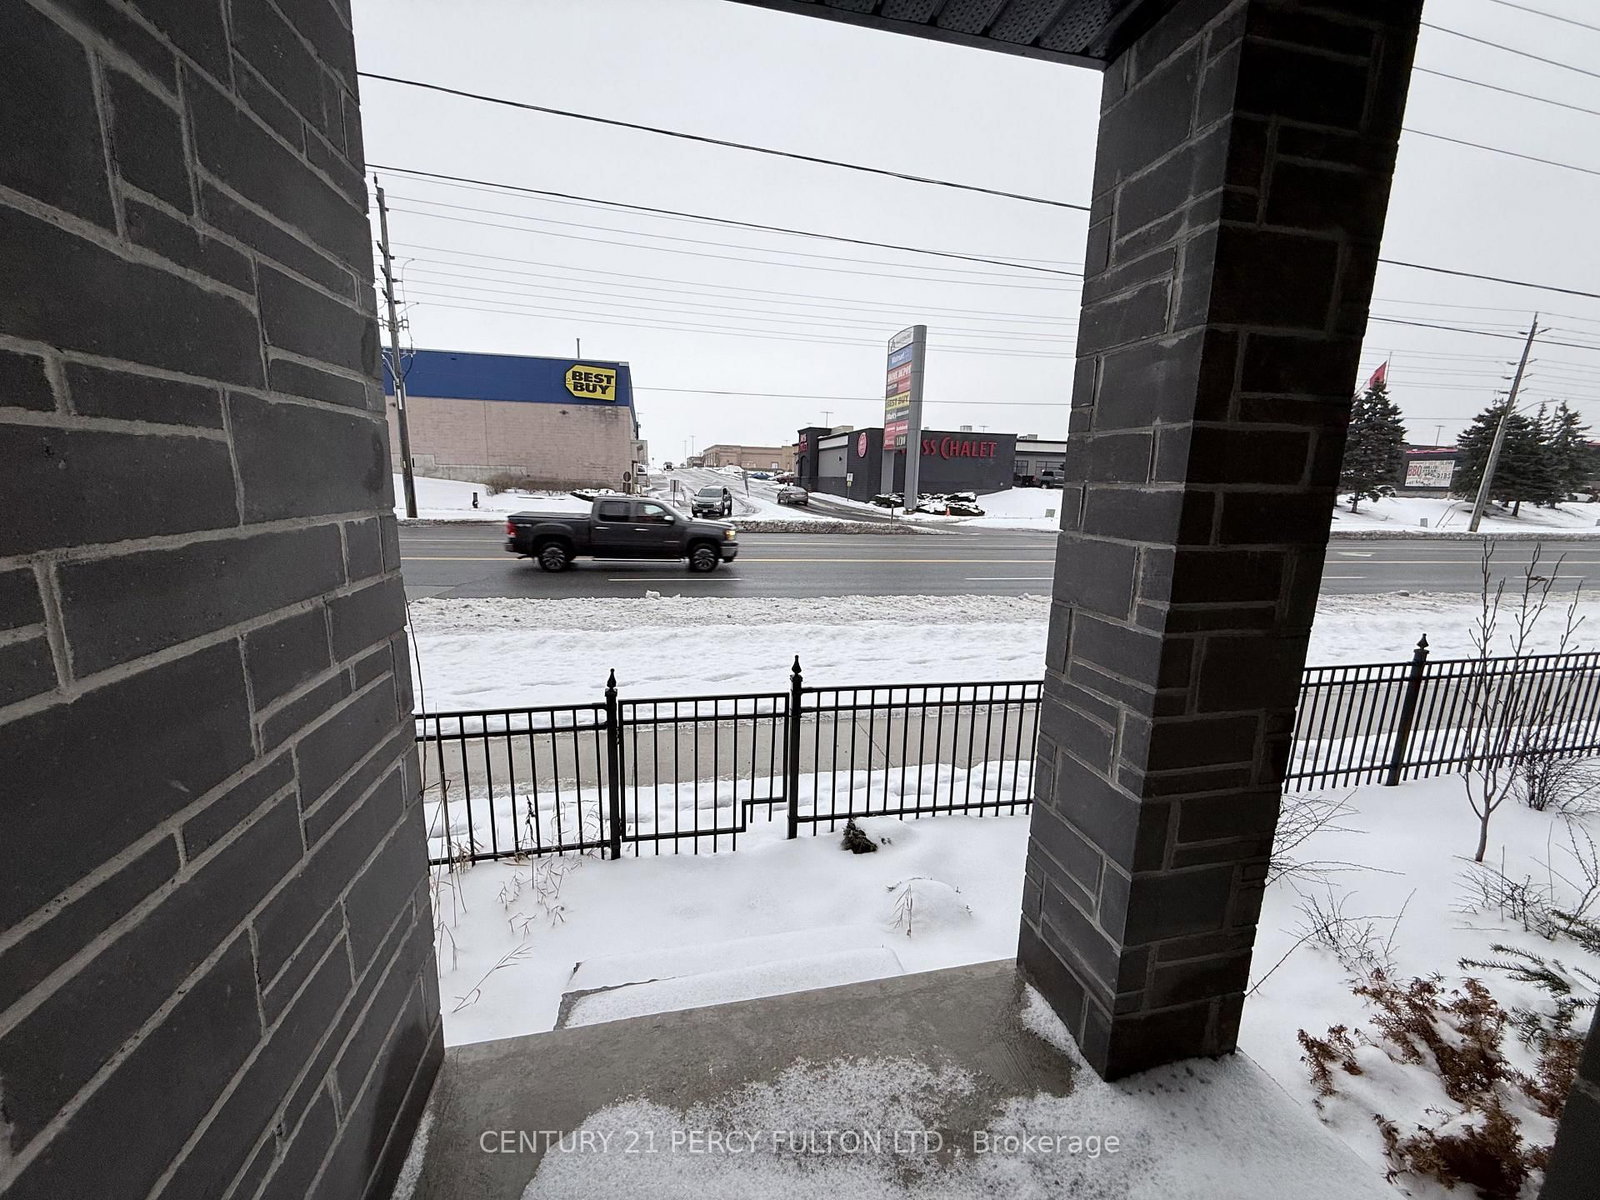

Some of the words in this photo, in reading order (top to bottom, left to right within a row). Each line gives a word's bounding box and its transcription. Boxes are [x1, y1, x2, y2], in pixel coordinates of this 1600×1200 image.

[572, 371, 614, 384] BEST
[573, 382, 610, 394] BUY
[941, 437, 997, 459] CHALET
